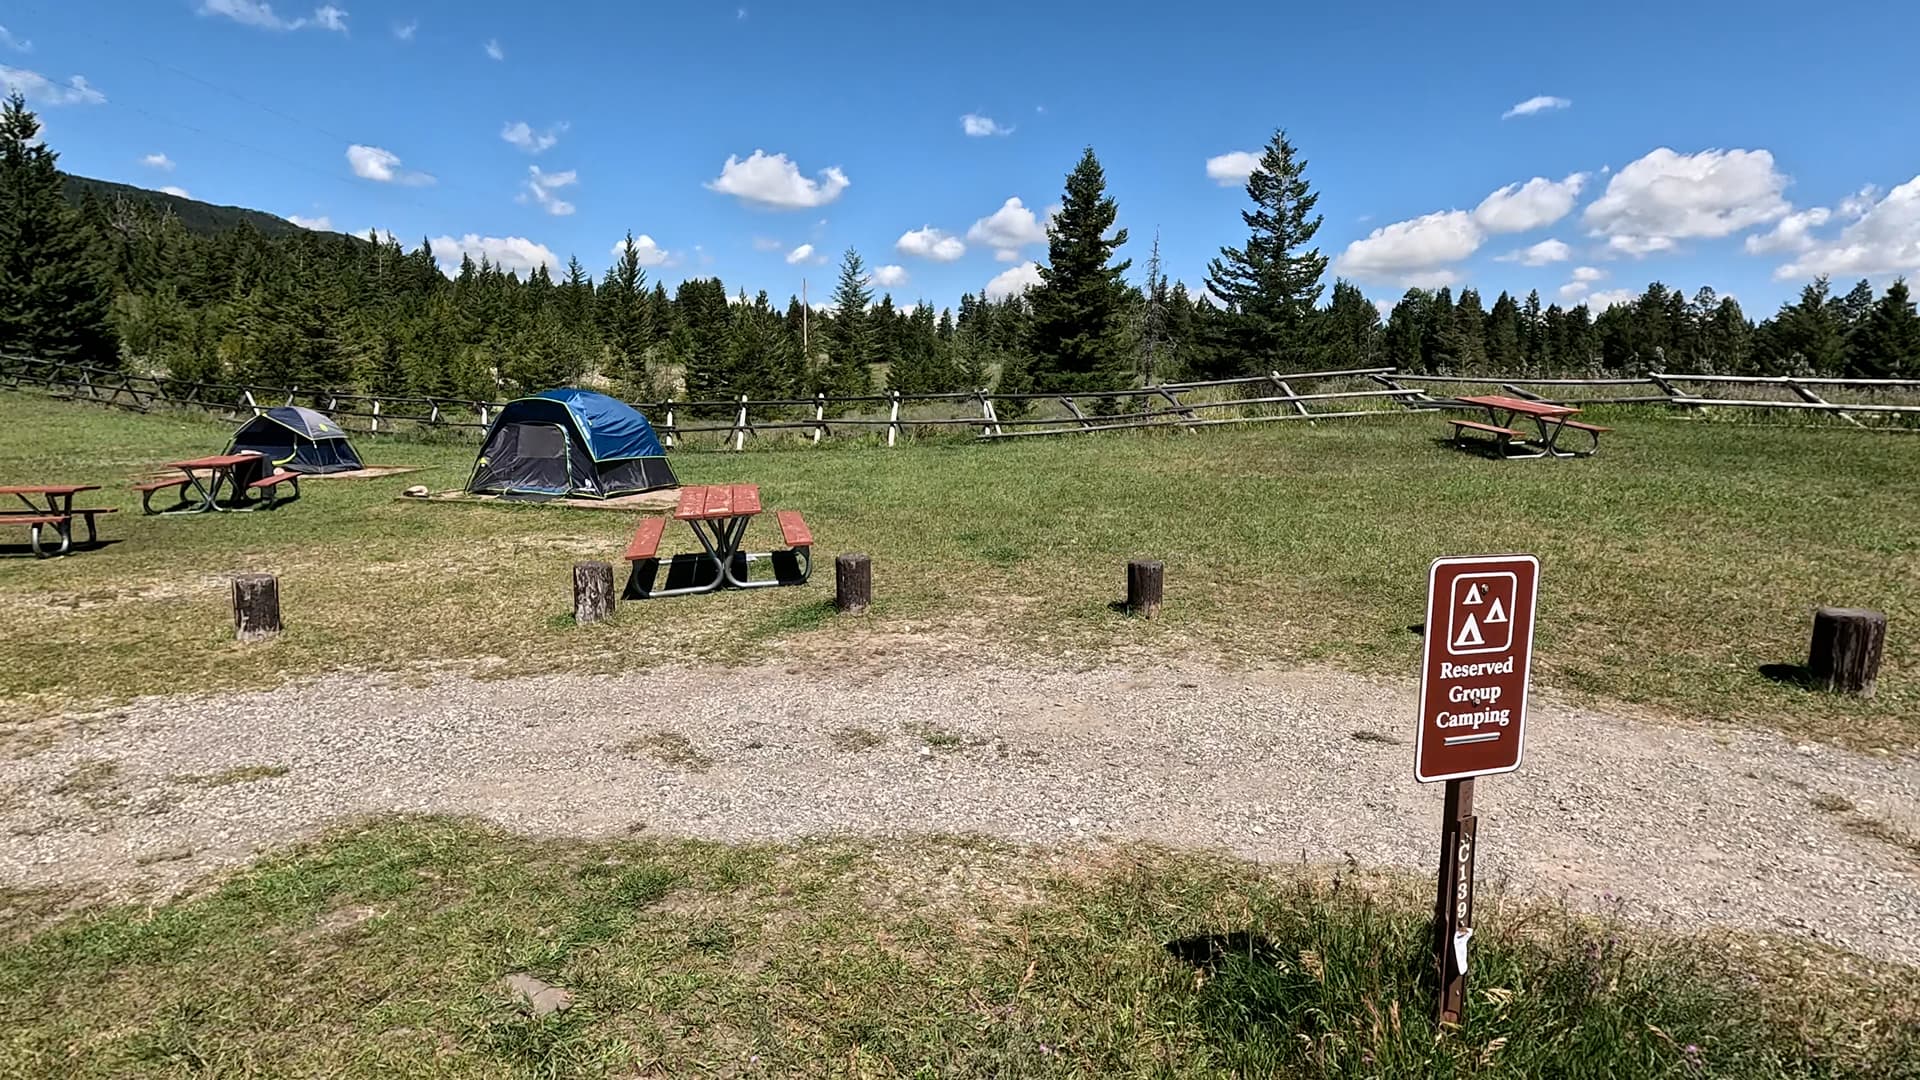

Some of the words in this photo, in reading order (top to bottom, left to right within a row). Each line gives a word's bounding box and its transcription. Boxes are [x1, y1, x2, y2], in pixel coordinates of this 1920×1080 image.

[1440, 656, 1514, 679] Reserved
[1448, 685, 1502, 703] Group
[1436, 707, 1511, 730] Camping
[1457, 844, 1470, 919] C139
